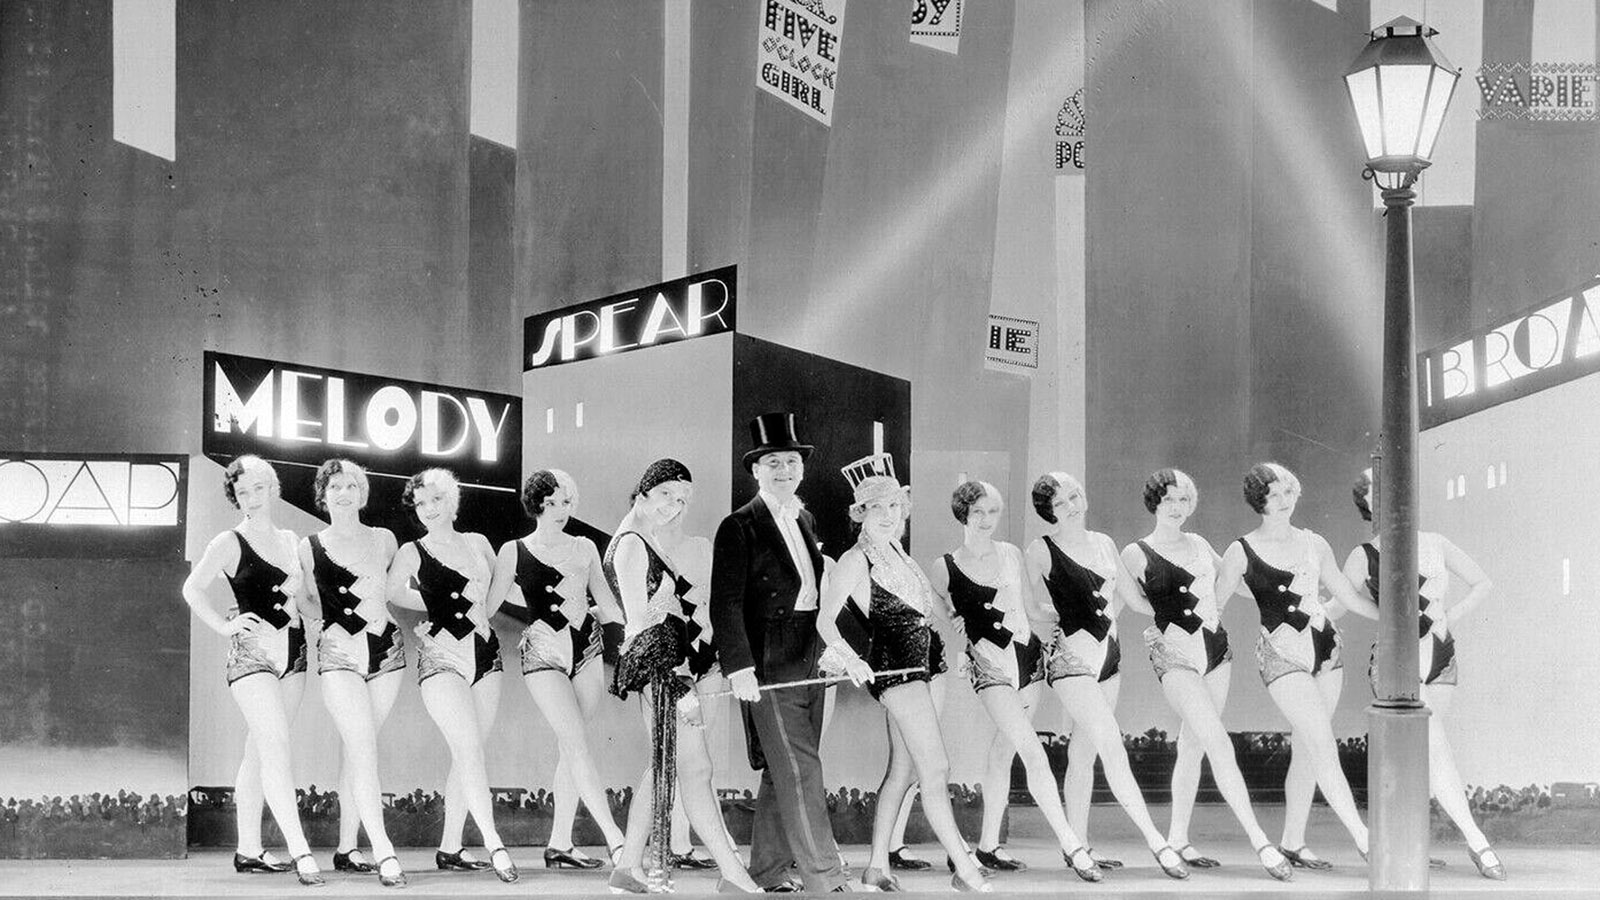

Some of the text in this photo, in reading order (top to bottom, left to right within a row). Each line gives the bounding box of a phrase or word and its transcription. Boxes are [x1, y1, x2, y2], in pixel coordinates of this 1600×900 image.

[765, 0, 837, 62] FIVE
[762, 36, 836, 90] O'CLOCK
[762, 62, 827, 115] GIRL
[1475, 74, 1600, 107] VARIE
[532, 279, 728, 366] SPEAR
[989, 325, 1031, 354] IE
[213, 361, 511, 462] MELODY
